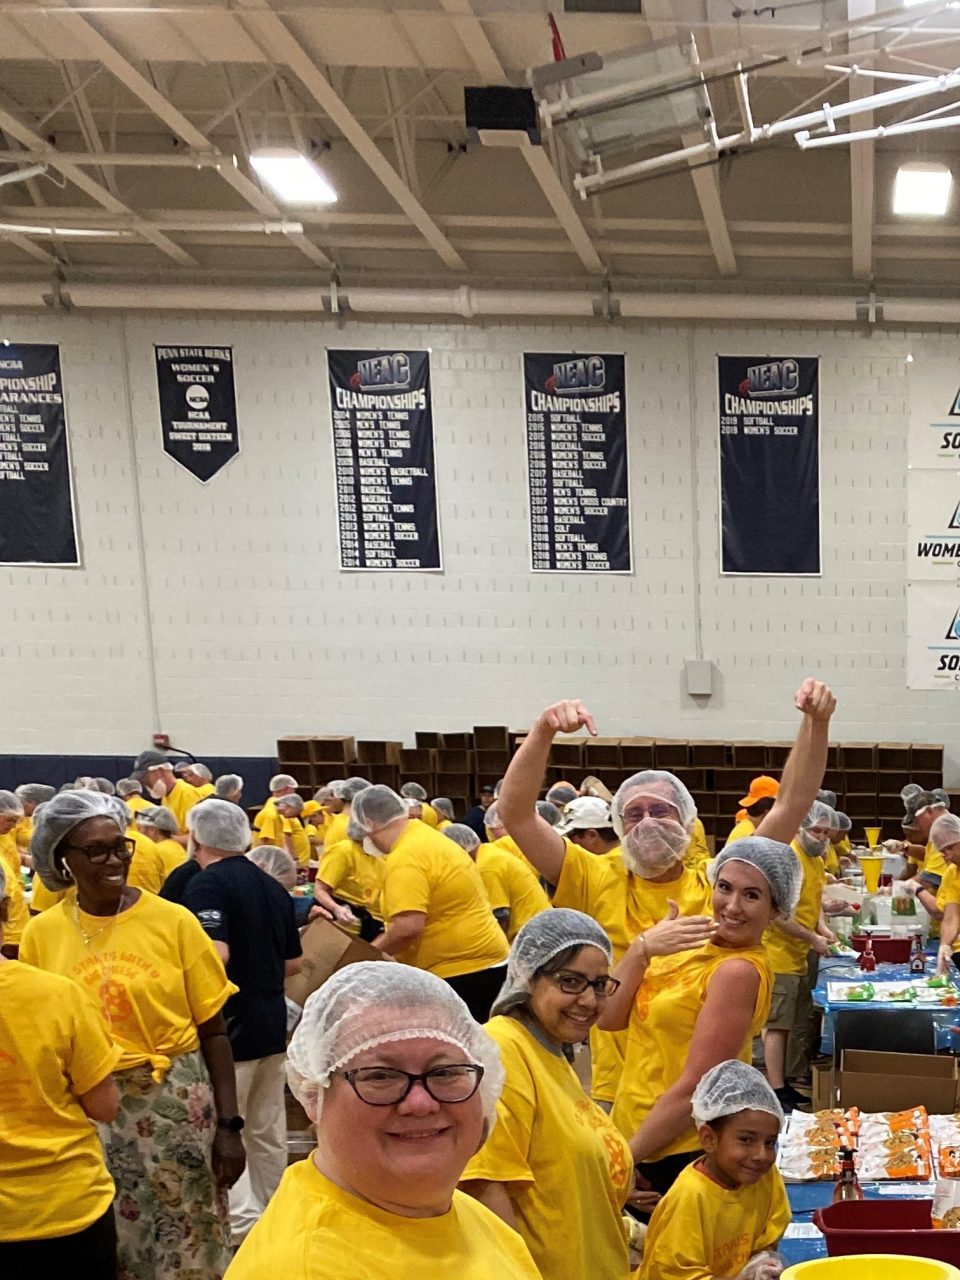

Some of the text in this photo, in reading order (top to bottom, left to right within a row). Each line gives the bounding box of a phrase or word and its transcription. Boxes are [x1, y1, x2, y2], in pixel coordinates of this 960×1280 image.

[158, 348, 179, 360] PENN
[180, 348, 202, 357] STATE
[171, 363, 220, 372] WOMEN'S
[176, 374, 215, 383] SOCCER
[358, 353, 410, 387] NEAC
[554, 355, 605, 390] NEAC
[747, 359, 799, 394] NEAC
[336, 387, 426, 409] CHAMPIONSHIPS
[531, 390, 620, 413] CHAMPIONSHIPS
[725, 393, 813, 415] CHAMPIONSHIPS
[743, 417, 774, 425] SOFTBALL
[744, 426, 770, 434] WOMEN'S
[774, 427, 798, 435] SOCCER
